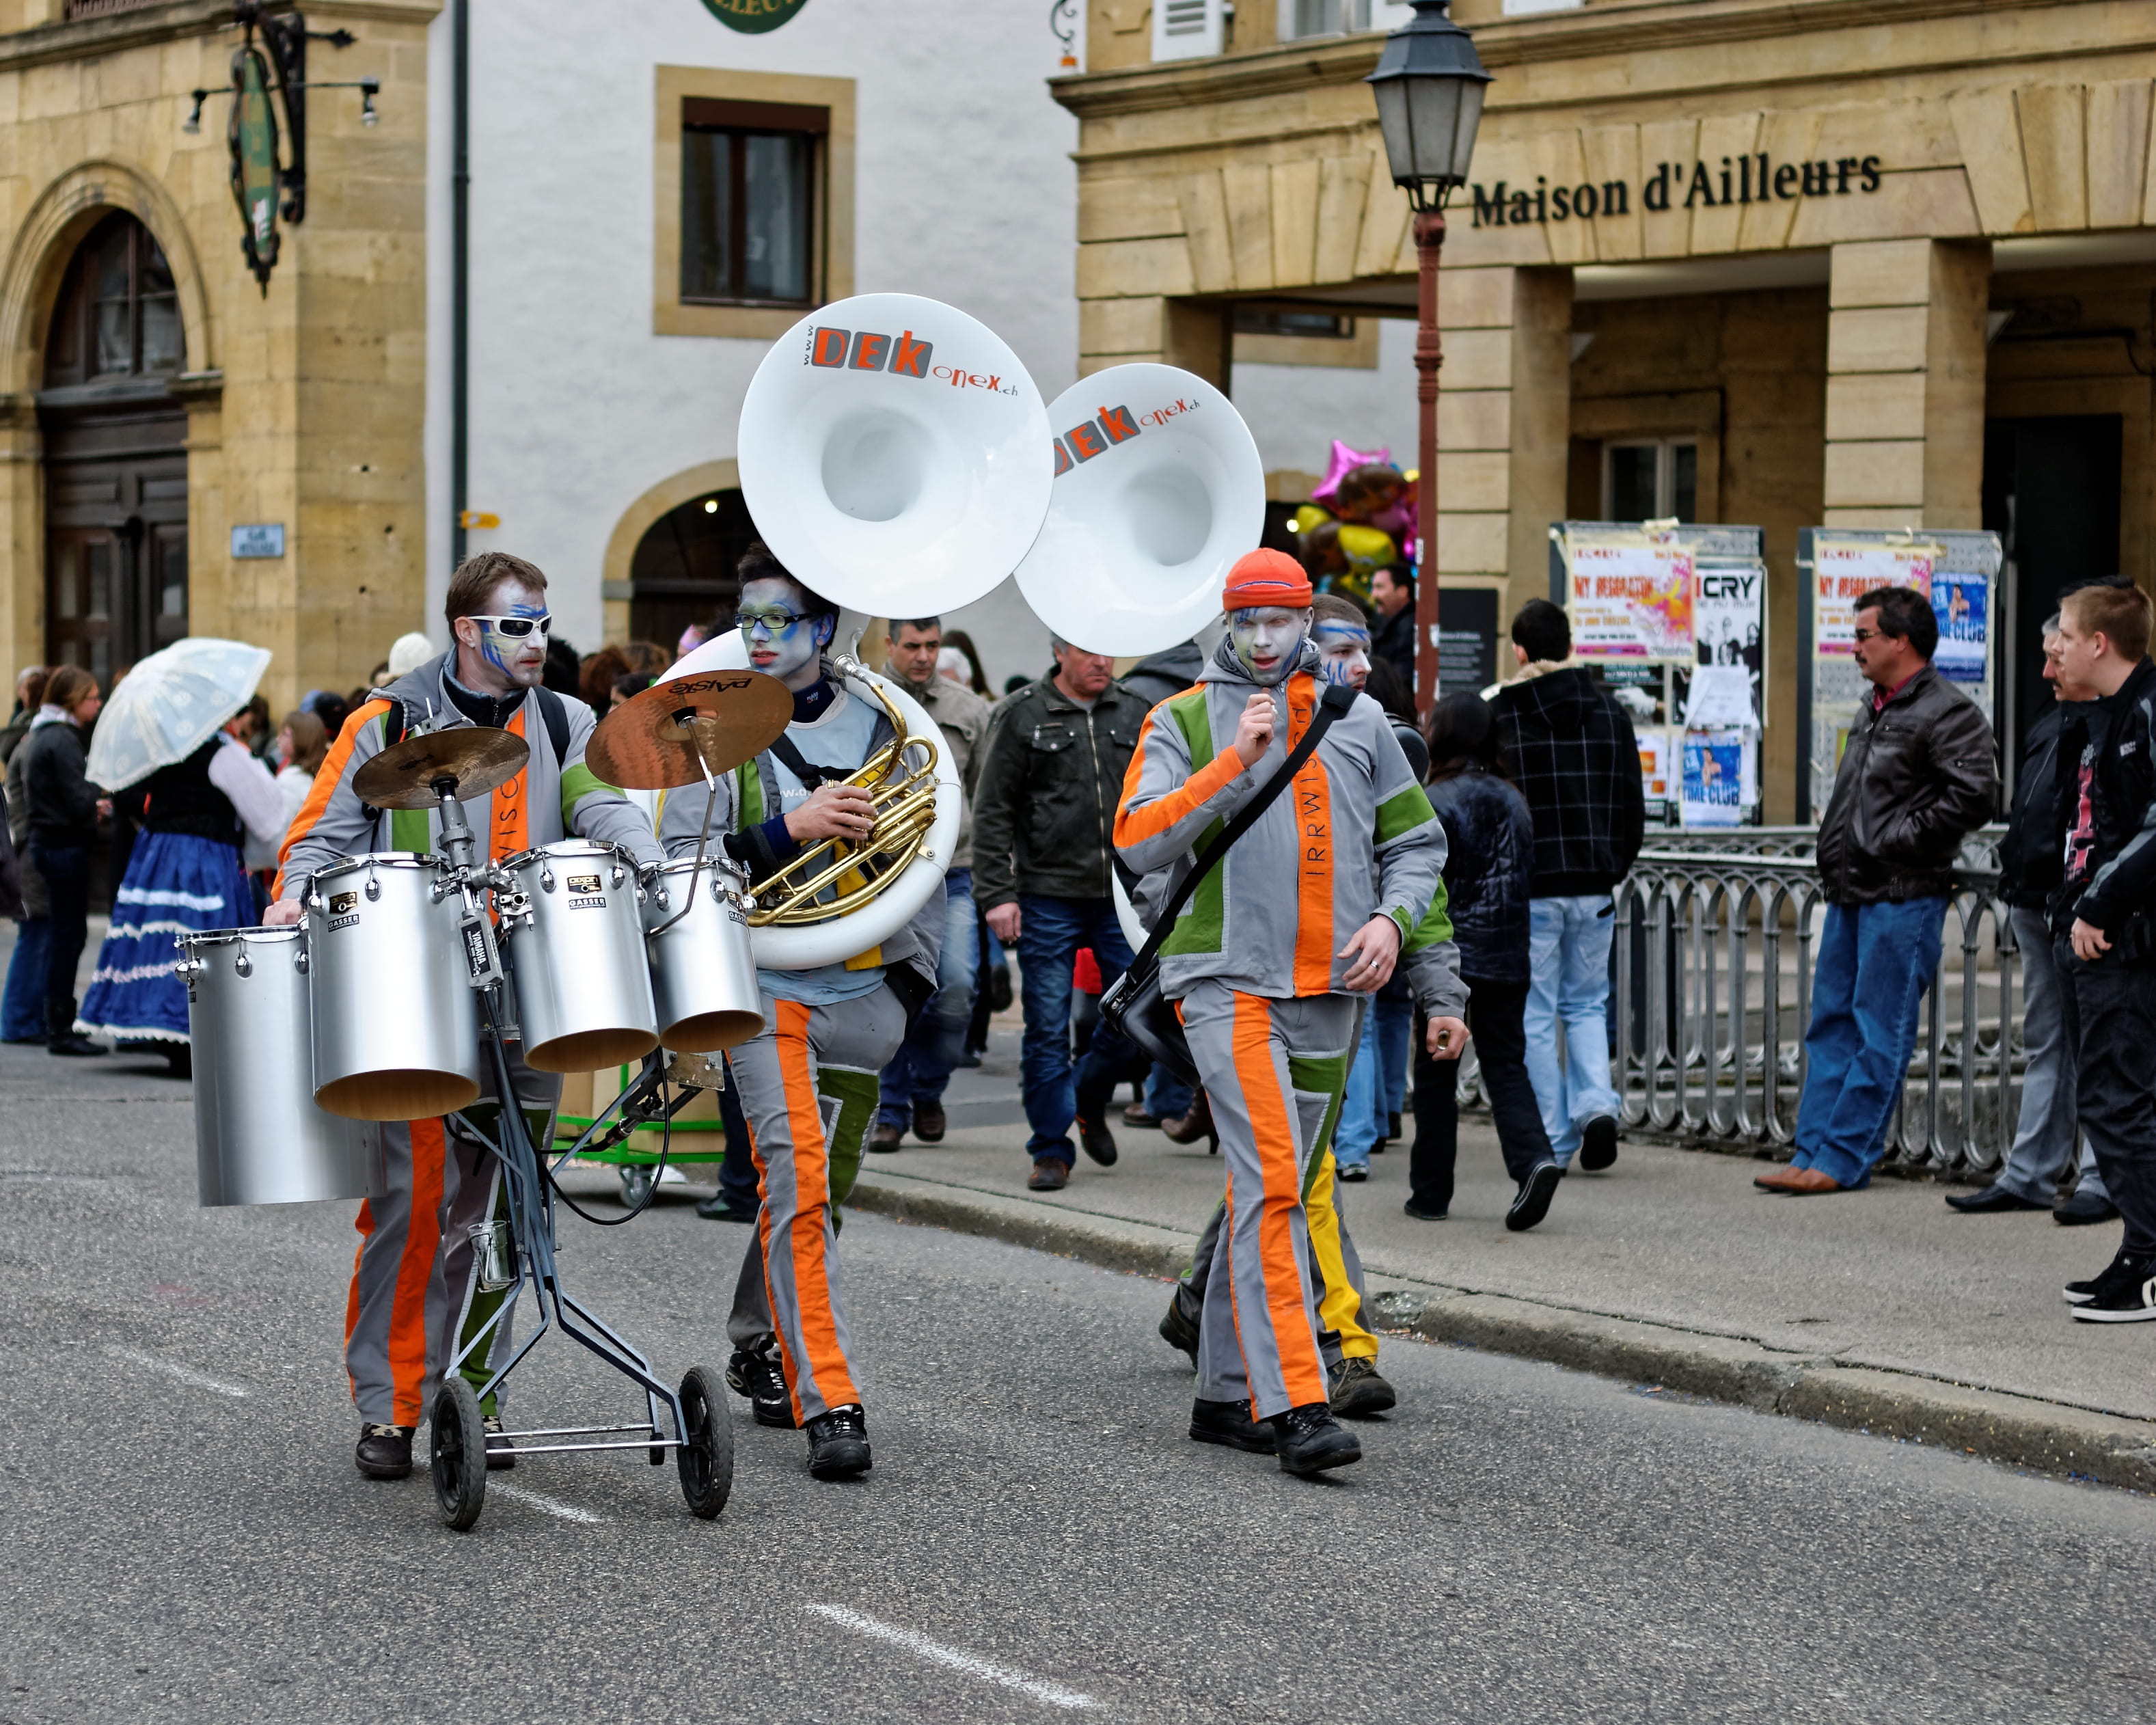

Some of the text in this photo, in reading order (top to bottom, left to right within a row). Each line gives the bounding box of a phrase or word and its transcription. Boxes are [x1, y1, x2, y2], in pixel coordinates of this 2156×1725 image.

[1471, 152, 1881, 228] Maison d'Ailleurs
[328, 915, 359, 928] GASSER
[472, 930, 487, 965] YAMAHA
